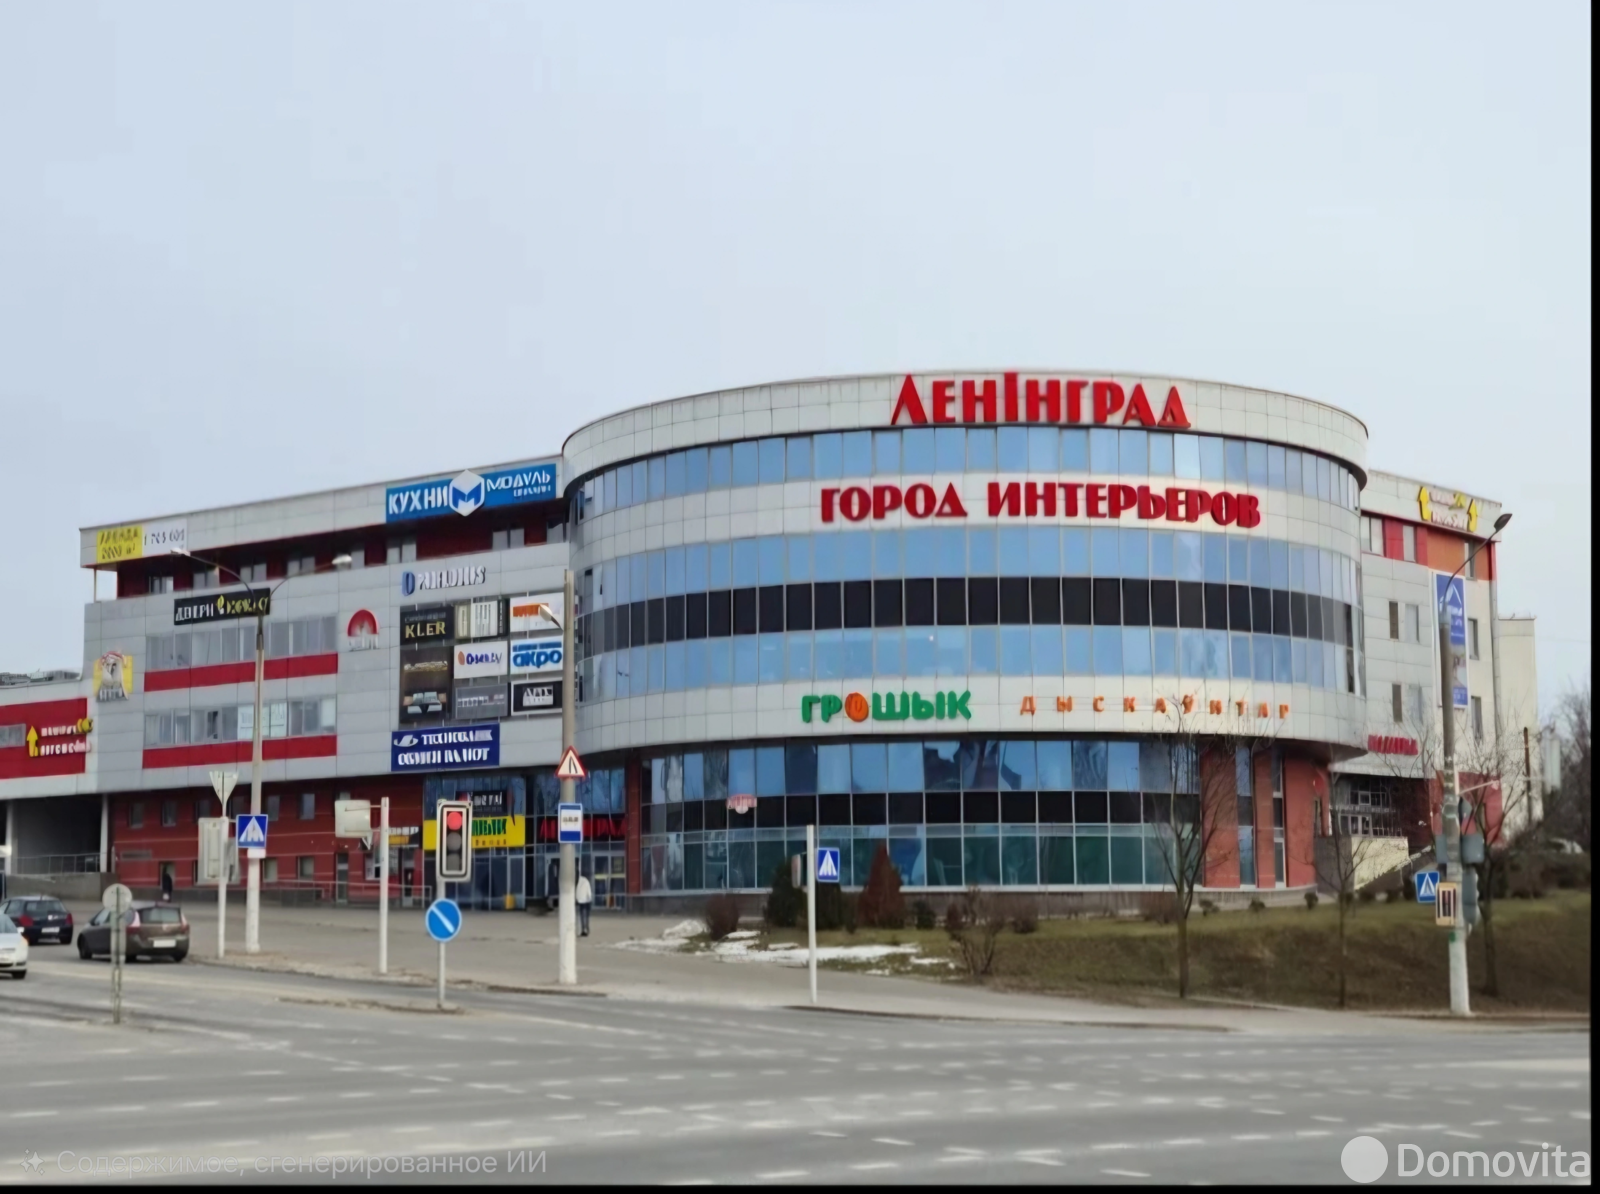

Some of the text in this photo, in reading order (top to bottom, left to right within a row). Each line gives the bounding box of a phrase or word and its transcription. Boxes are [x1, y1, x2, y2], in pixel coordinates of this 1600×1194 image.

[388, 486, 447, 514] КУХНИ
[821, 482, 1261, 528] ГОРОД ИНТЕРЬЕРОВ
[405, 621, 446, 639] KLER
[801, 690, 971, 723] ГРОШЫК
